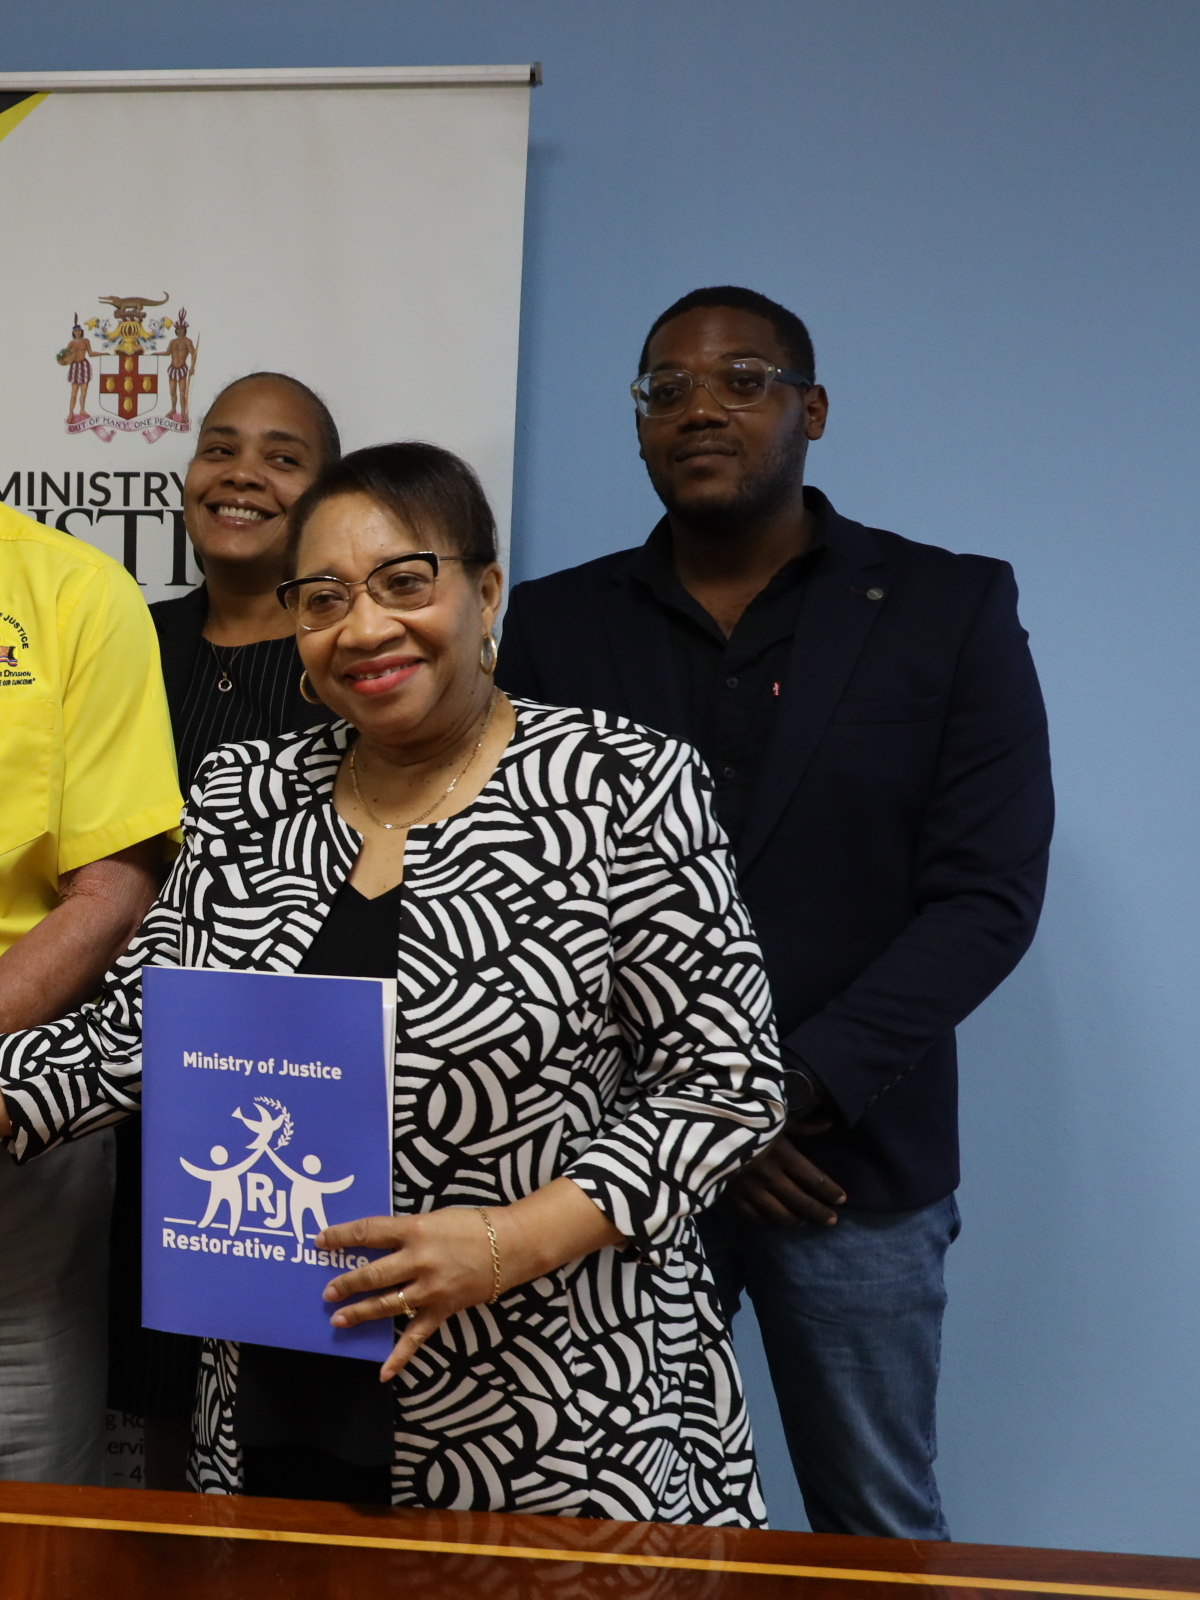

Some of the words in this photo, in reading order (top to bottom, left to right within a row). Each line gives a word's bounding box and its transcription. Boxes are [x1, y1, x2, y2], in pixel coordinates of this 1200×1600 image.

[69, 421, 87, 433] OUT
[89, 417, 100, 426] OF
[134, 417, 152, 429] ONE
[154, 417, 186, 432] PEOPLE
[3, 615, 29, 649] JUSTICE
[4, 669, 31, 678] DIVISION
[183, 1051, 254, 1076] Ministry
[257, 1058, 275, 1075] of
[278, 1059, 343, 1080] Justice
[246, 1172, 287, 1229] RJ
[162, 1228, 286, 1262] Restorative
[290, 1243, 370, 1270] Justice
